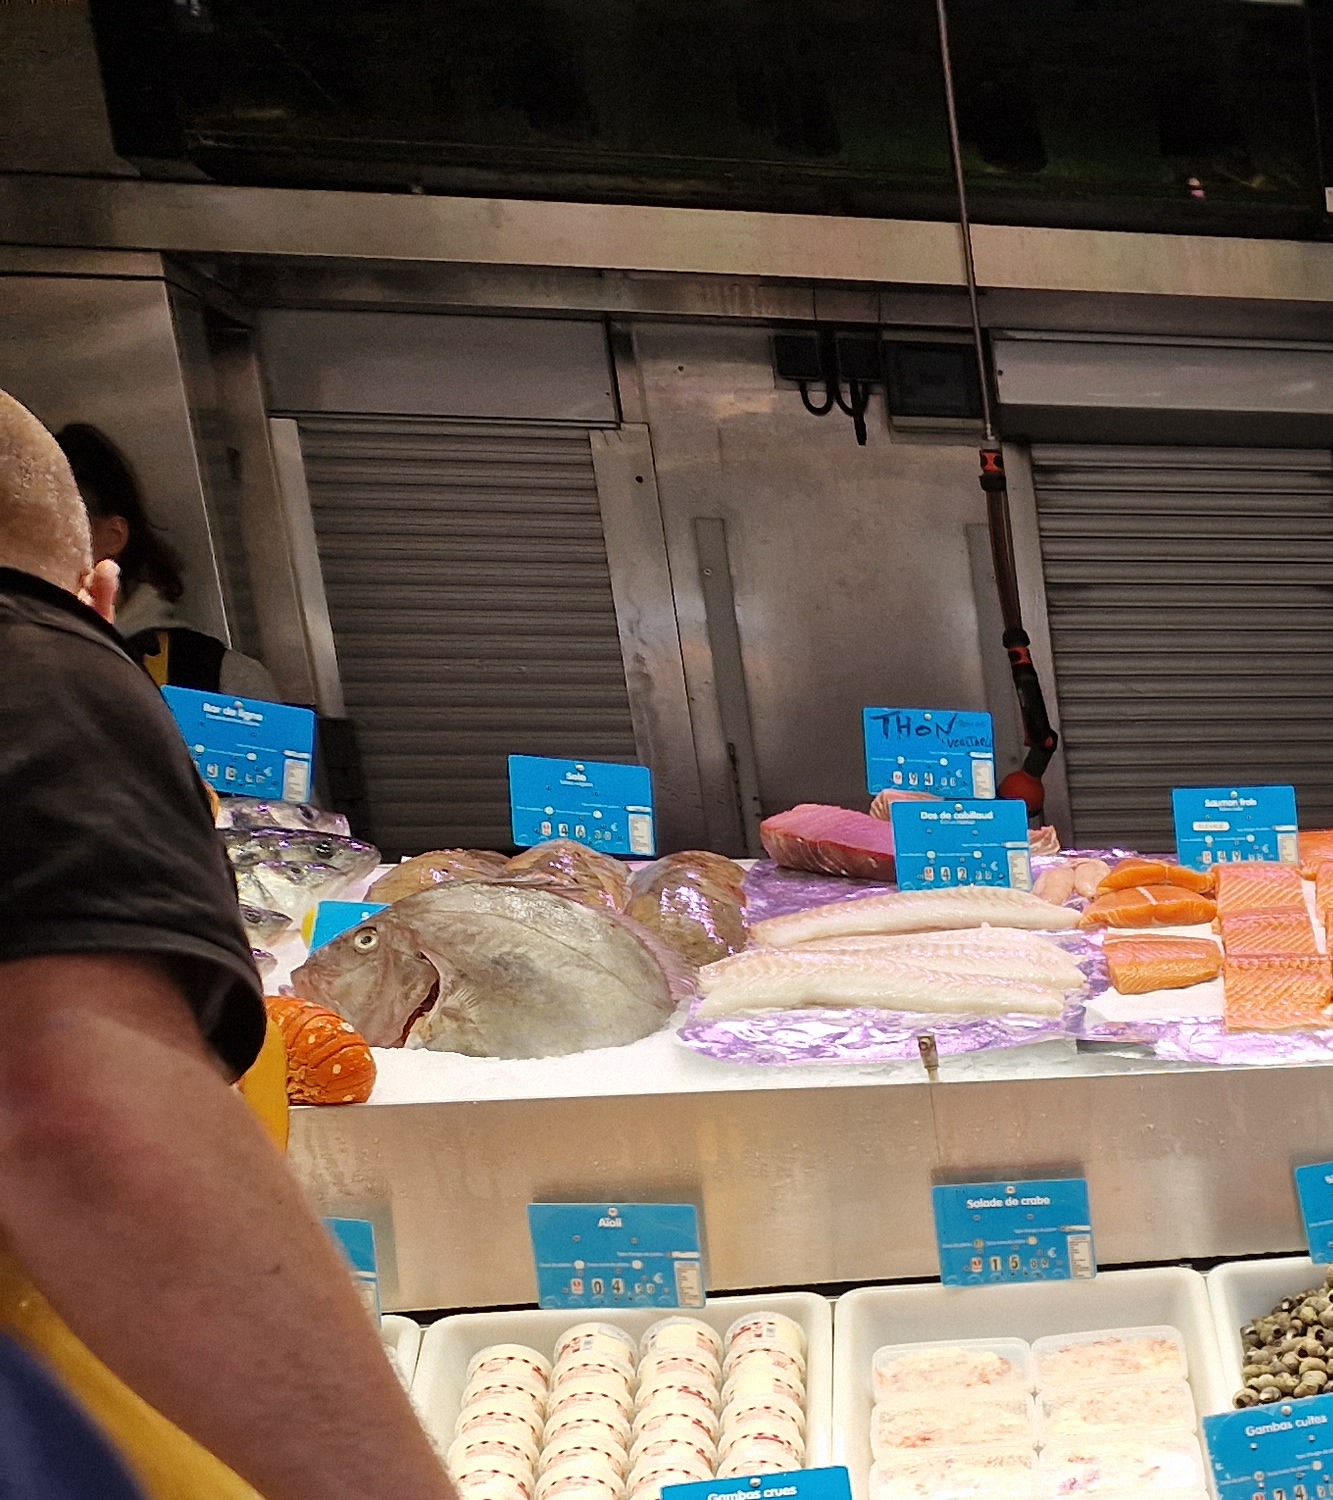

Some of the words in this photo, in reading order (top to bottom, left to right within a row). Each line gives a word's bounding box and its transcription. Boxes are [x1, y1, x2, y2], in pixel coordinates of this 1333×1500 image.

[870, 711, 957, 739] THON
[940, 811, 952, 820] de
[966, 1198, 1003, 1209] Salade
[1005, 1197, 1019, 1207] de
[1021, 1195, 1051, 1206] crabe
[1245, 1421, 1294, 1437] Gambas
[1296, 1414, 1328, 1428] cuites
[763, 1485, 797, 1498] crues
